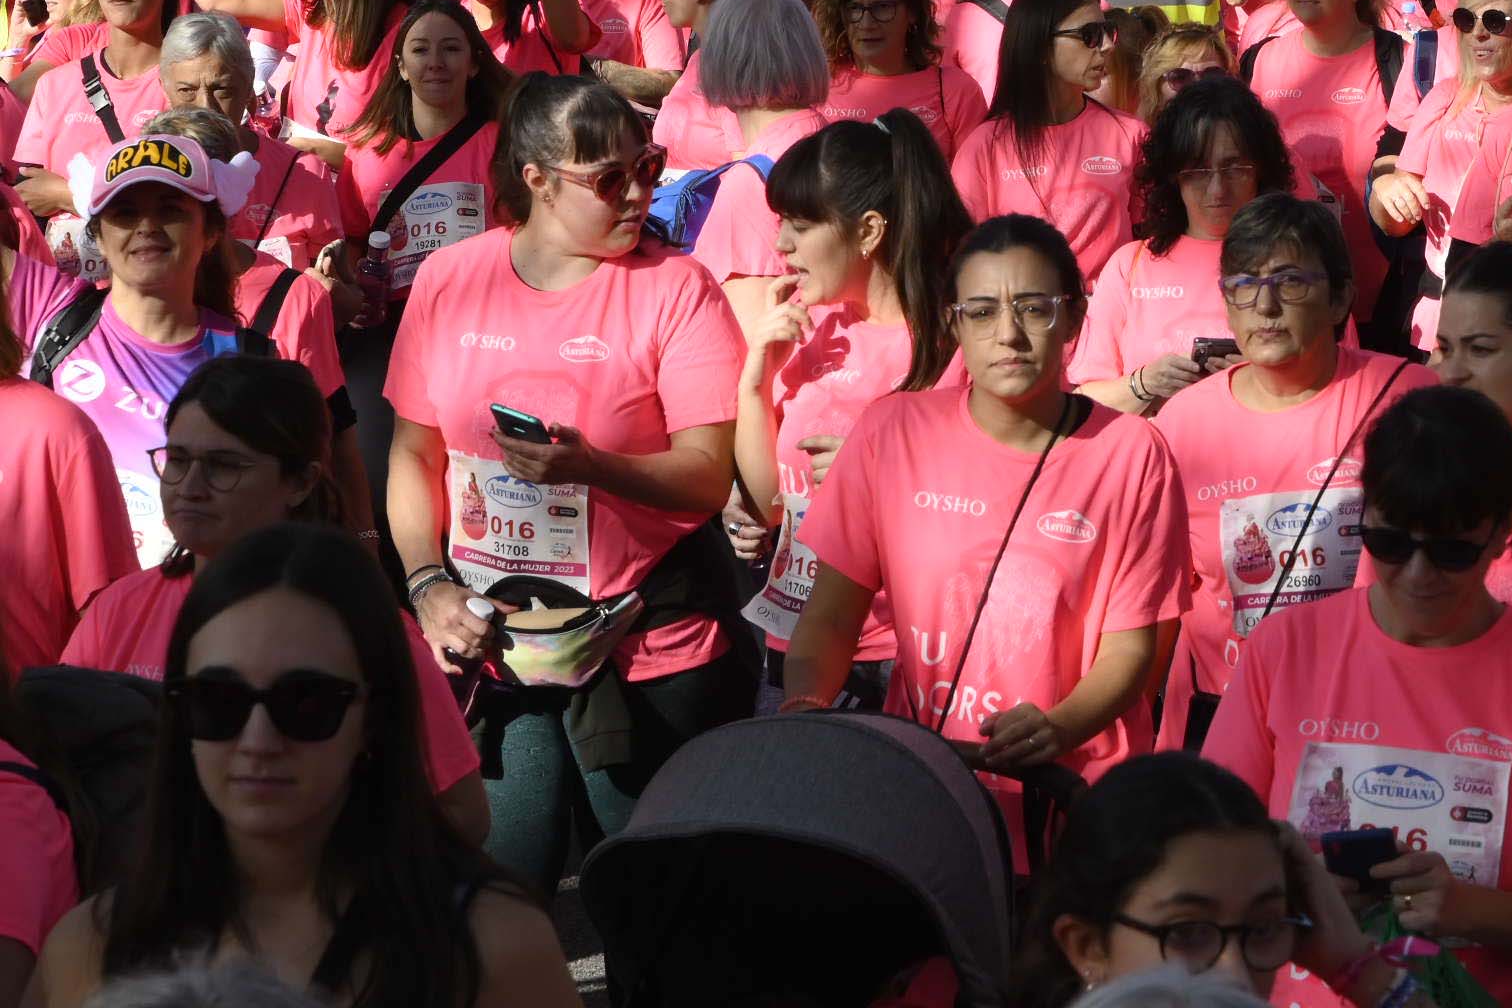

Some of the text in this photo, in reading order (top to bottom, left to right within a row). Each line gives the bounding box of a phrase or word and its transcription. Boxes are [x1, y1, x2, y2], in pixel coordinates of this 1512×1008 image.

[1265, 88, 1303, 100] OYSHO
[108, 141, 188, 181] ARALE
[411, 221, 447, 237] 016
[1132, 285, 1184, 299] OYSHO
[461, 332, 516, 352] OYSHO
[489, 483, 537, 503] ASTURIANA
[547, 488, 577, 498] SUMA
[1197, 476, 1257, 501] OYSHO
[915, 490, 987, 517] OYSHO
[491, 516, 535, 539] 016
[494, 541, 529, 557] 31708
[464, 552, 575, 573] CARRERA DE LA MUJER 2023
[1286, 574, 1321, 588] 26960
[1299, 718, 1380, 741] OYSHO
[1360, 778, 1436, 801] ASTURIANA
[1453, 783, 1494, 797] SUMA
